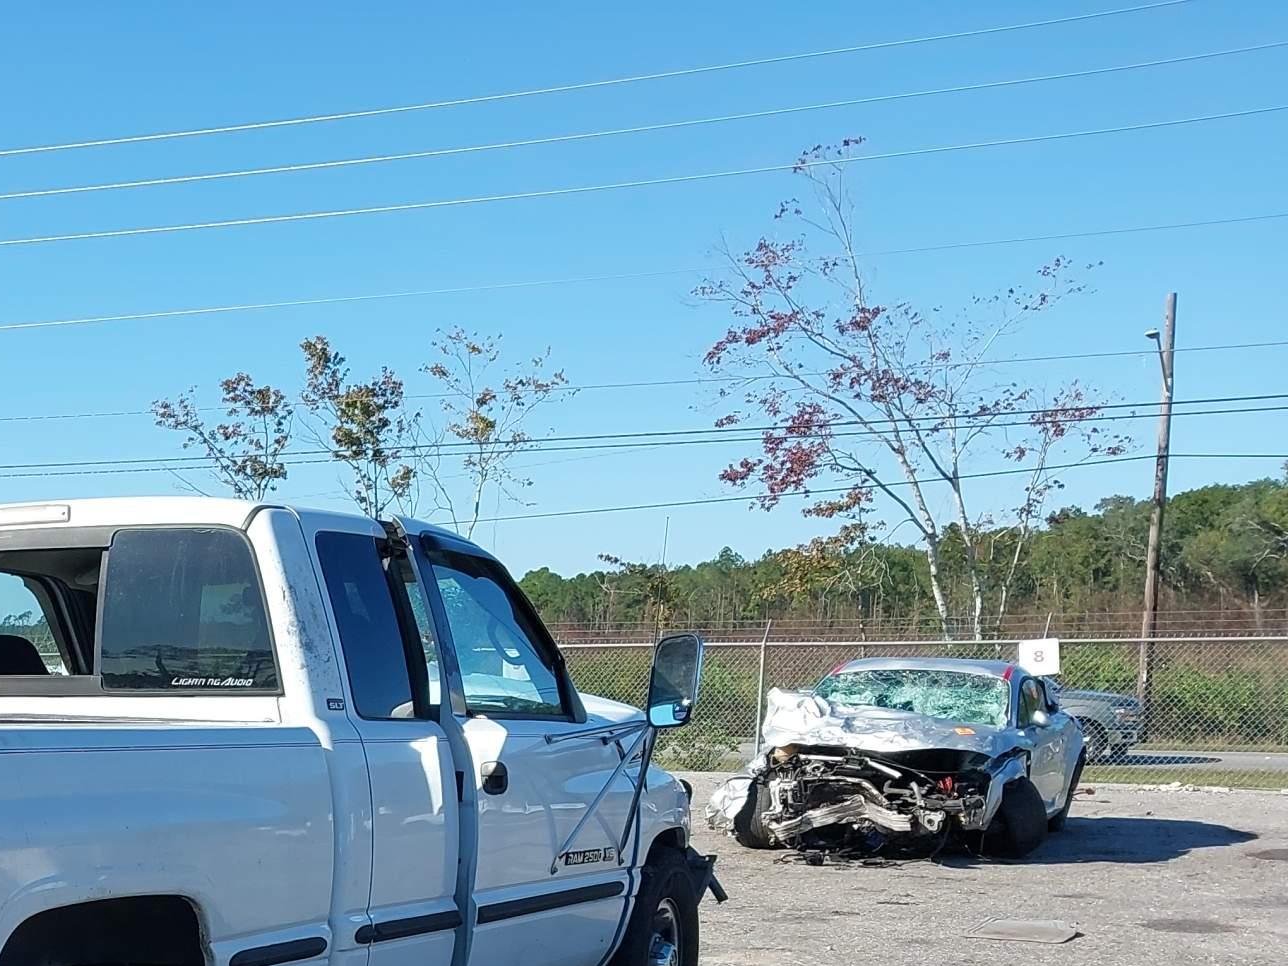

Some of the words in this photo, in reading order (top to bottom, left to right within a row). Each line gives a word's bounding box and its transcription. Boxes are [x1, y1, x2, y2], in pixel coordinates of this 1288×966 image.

[1033, 650, 1045, 663] 8
[329, 702, 344, 710] SLT
[567, 852, 584, 865] RAM
[584, 850, 602, 863] 2500
